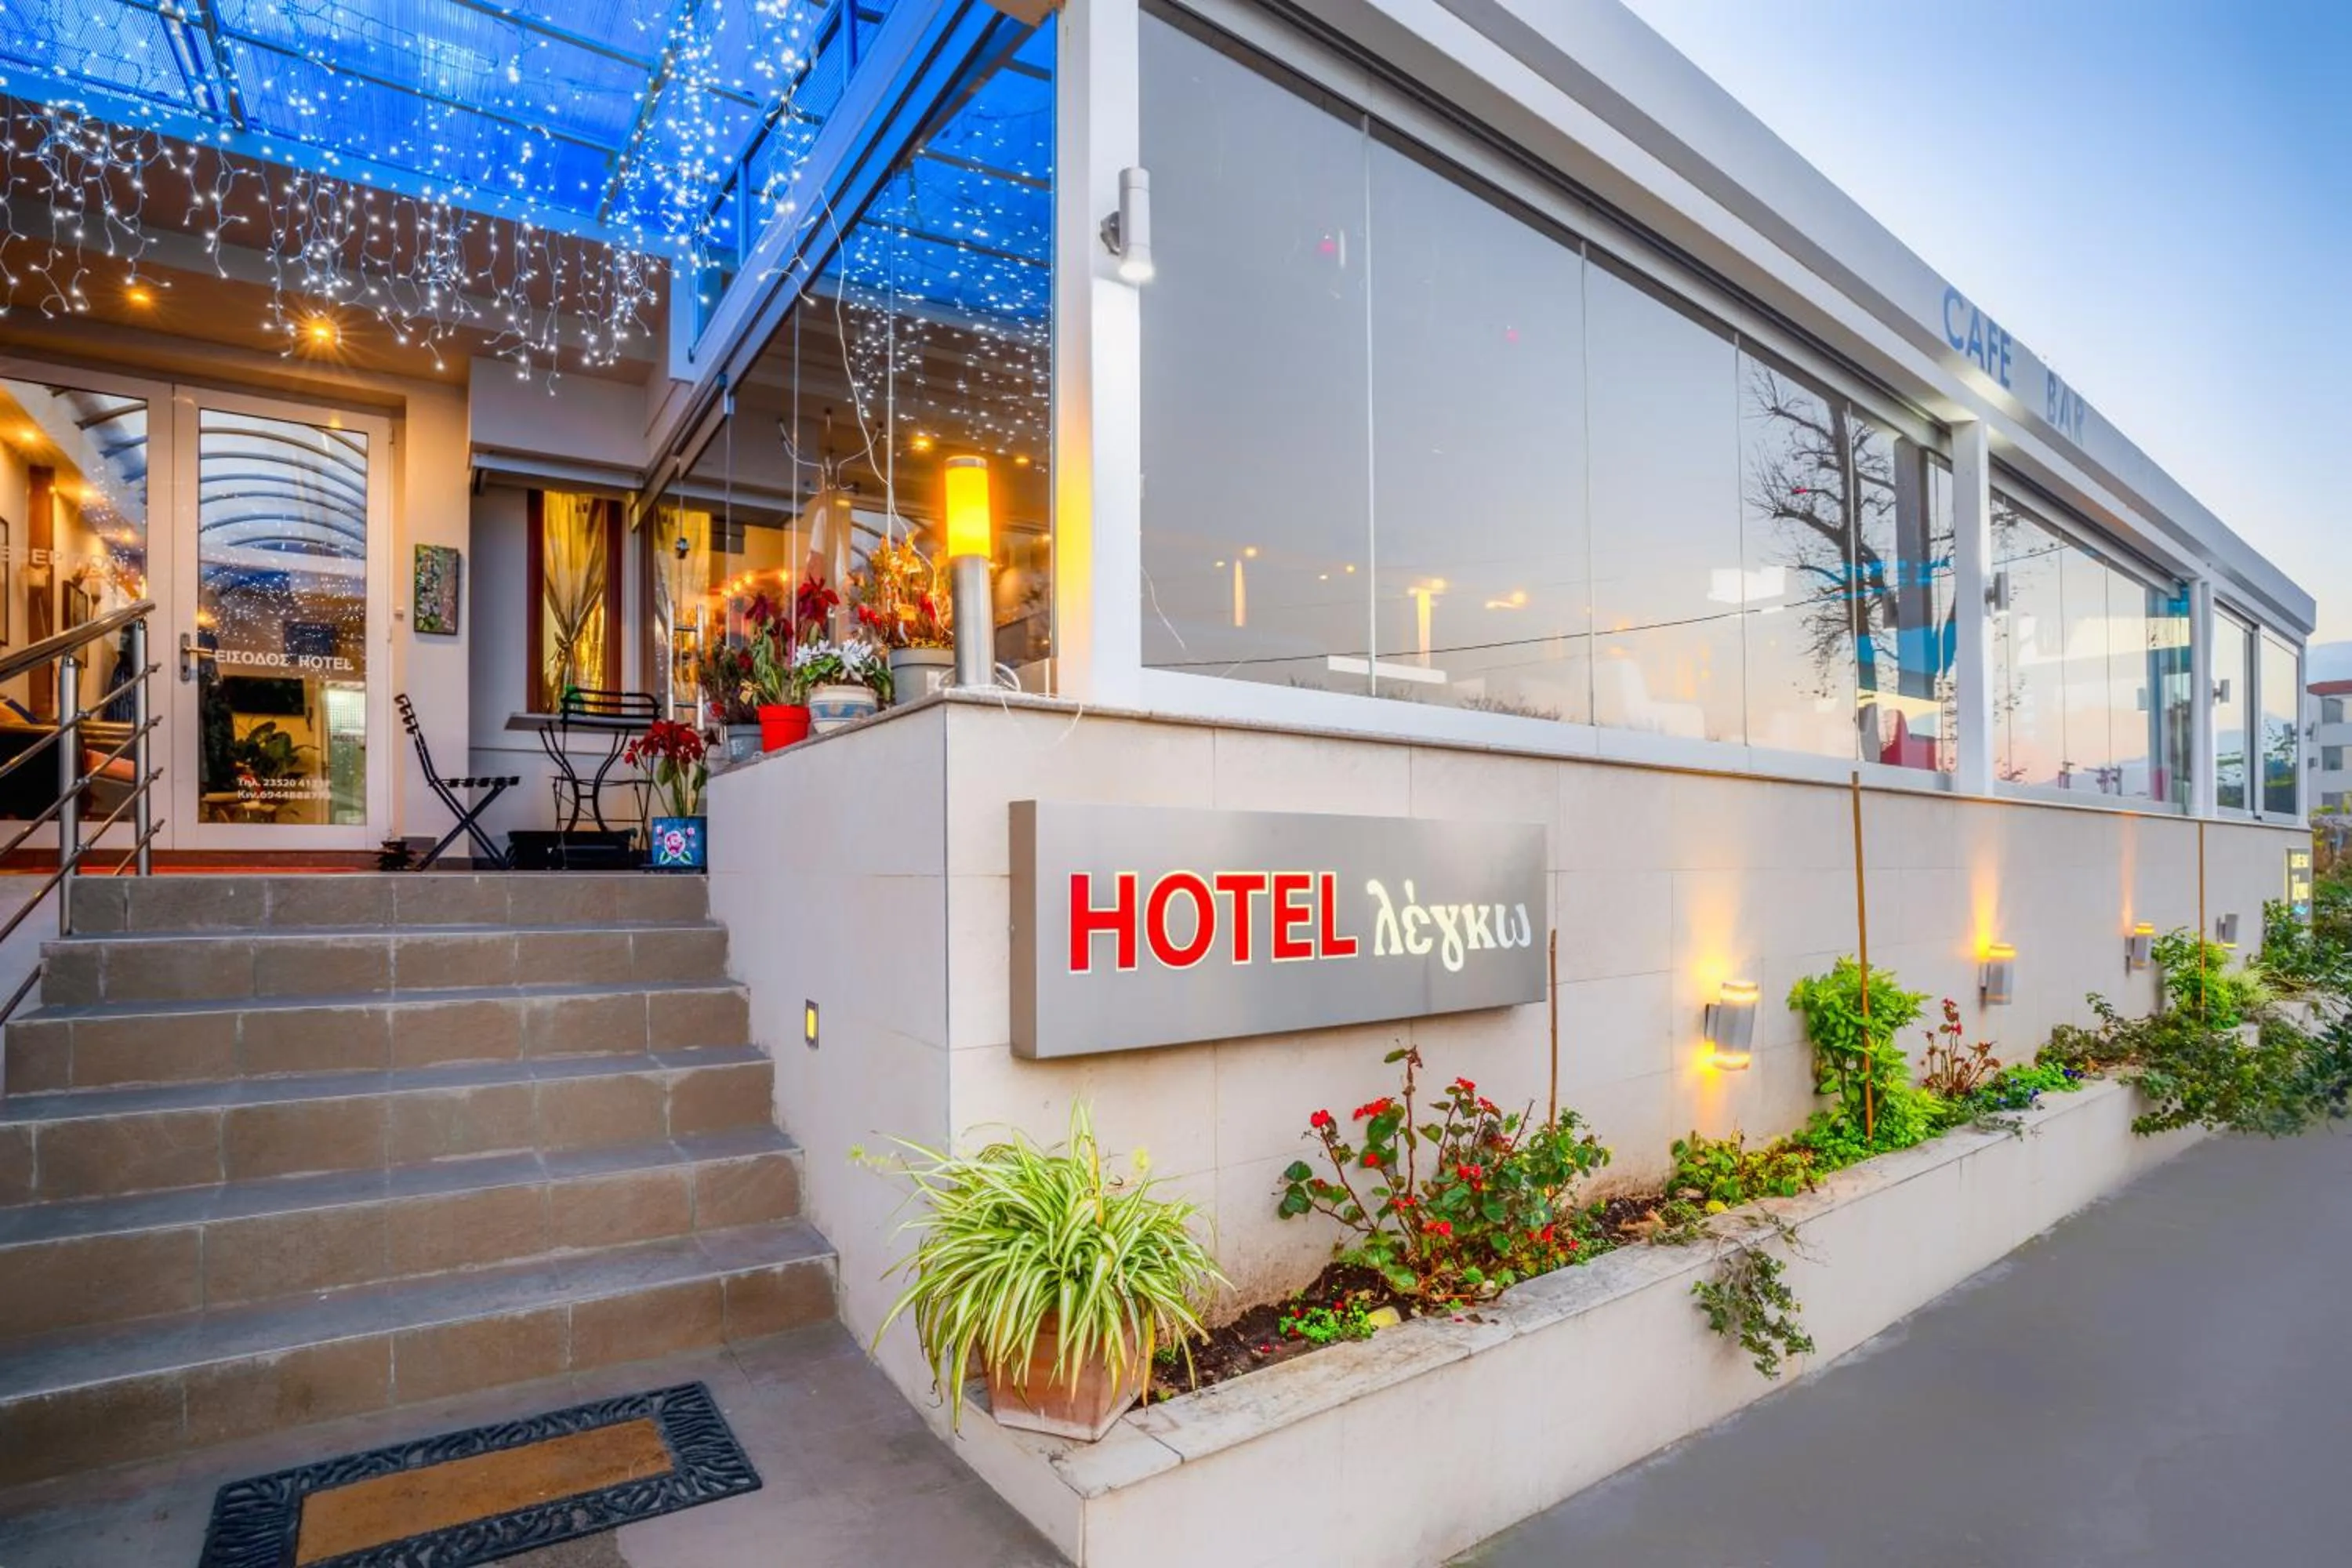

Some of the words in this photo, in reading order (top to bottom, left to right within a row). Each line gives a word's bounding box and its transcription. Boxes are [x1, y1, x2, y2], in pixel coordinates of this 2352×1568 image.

[1943, 285, 2013, 390] CAFE
[2047, 367, 2085, 447] BAR
[215, 650, 290, 667] ΕΙΣΟΔΟΣ
[298, 655, 355, 671] HOTEL
[1068, 869, 1359, 975] HOTEL
[1366, 877, 1532, 973] λέγκω
